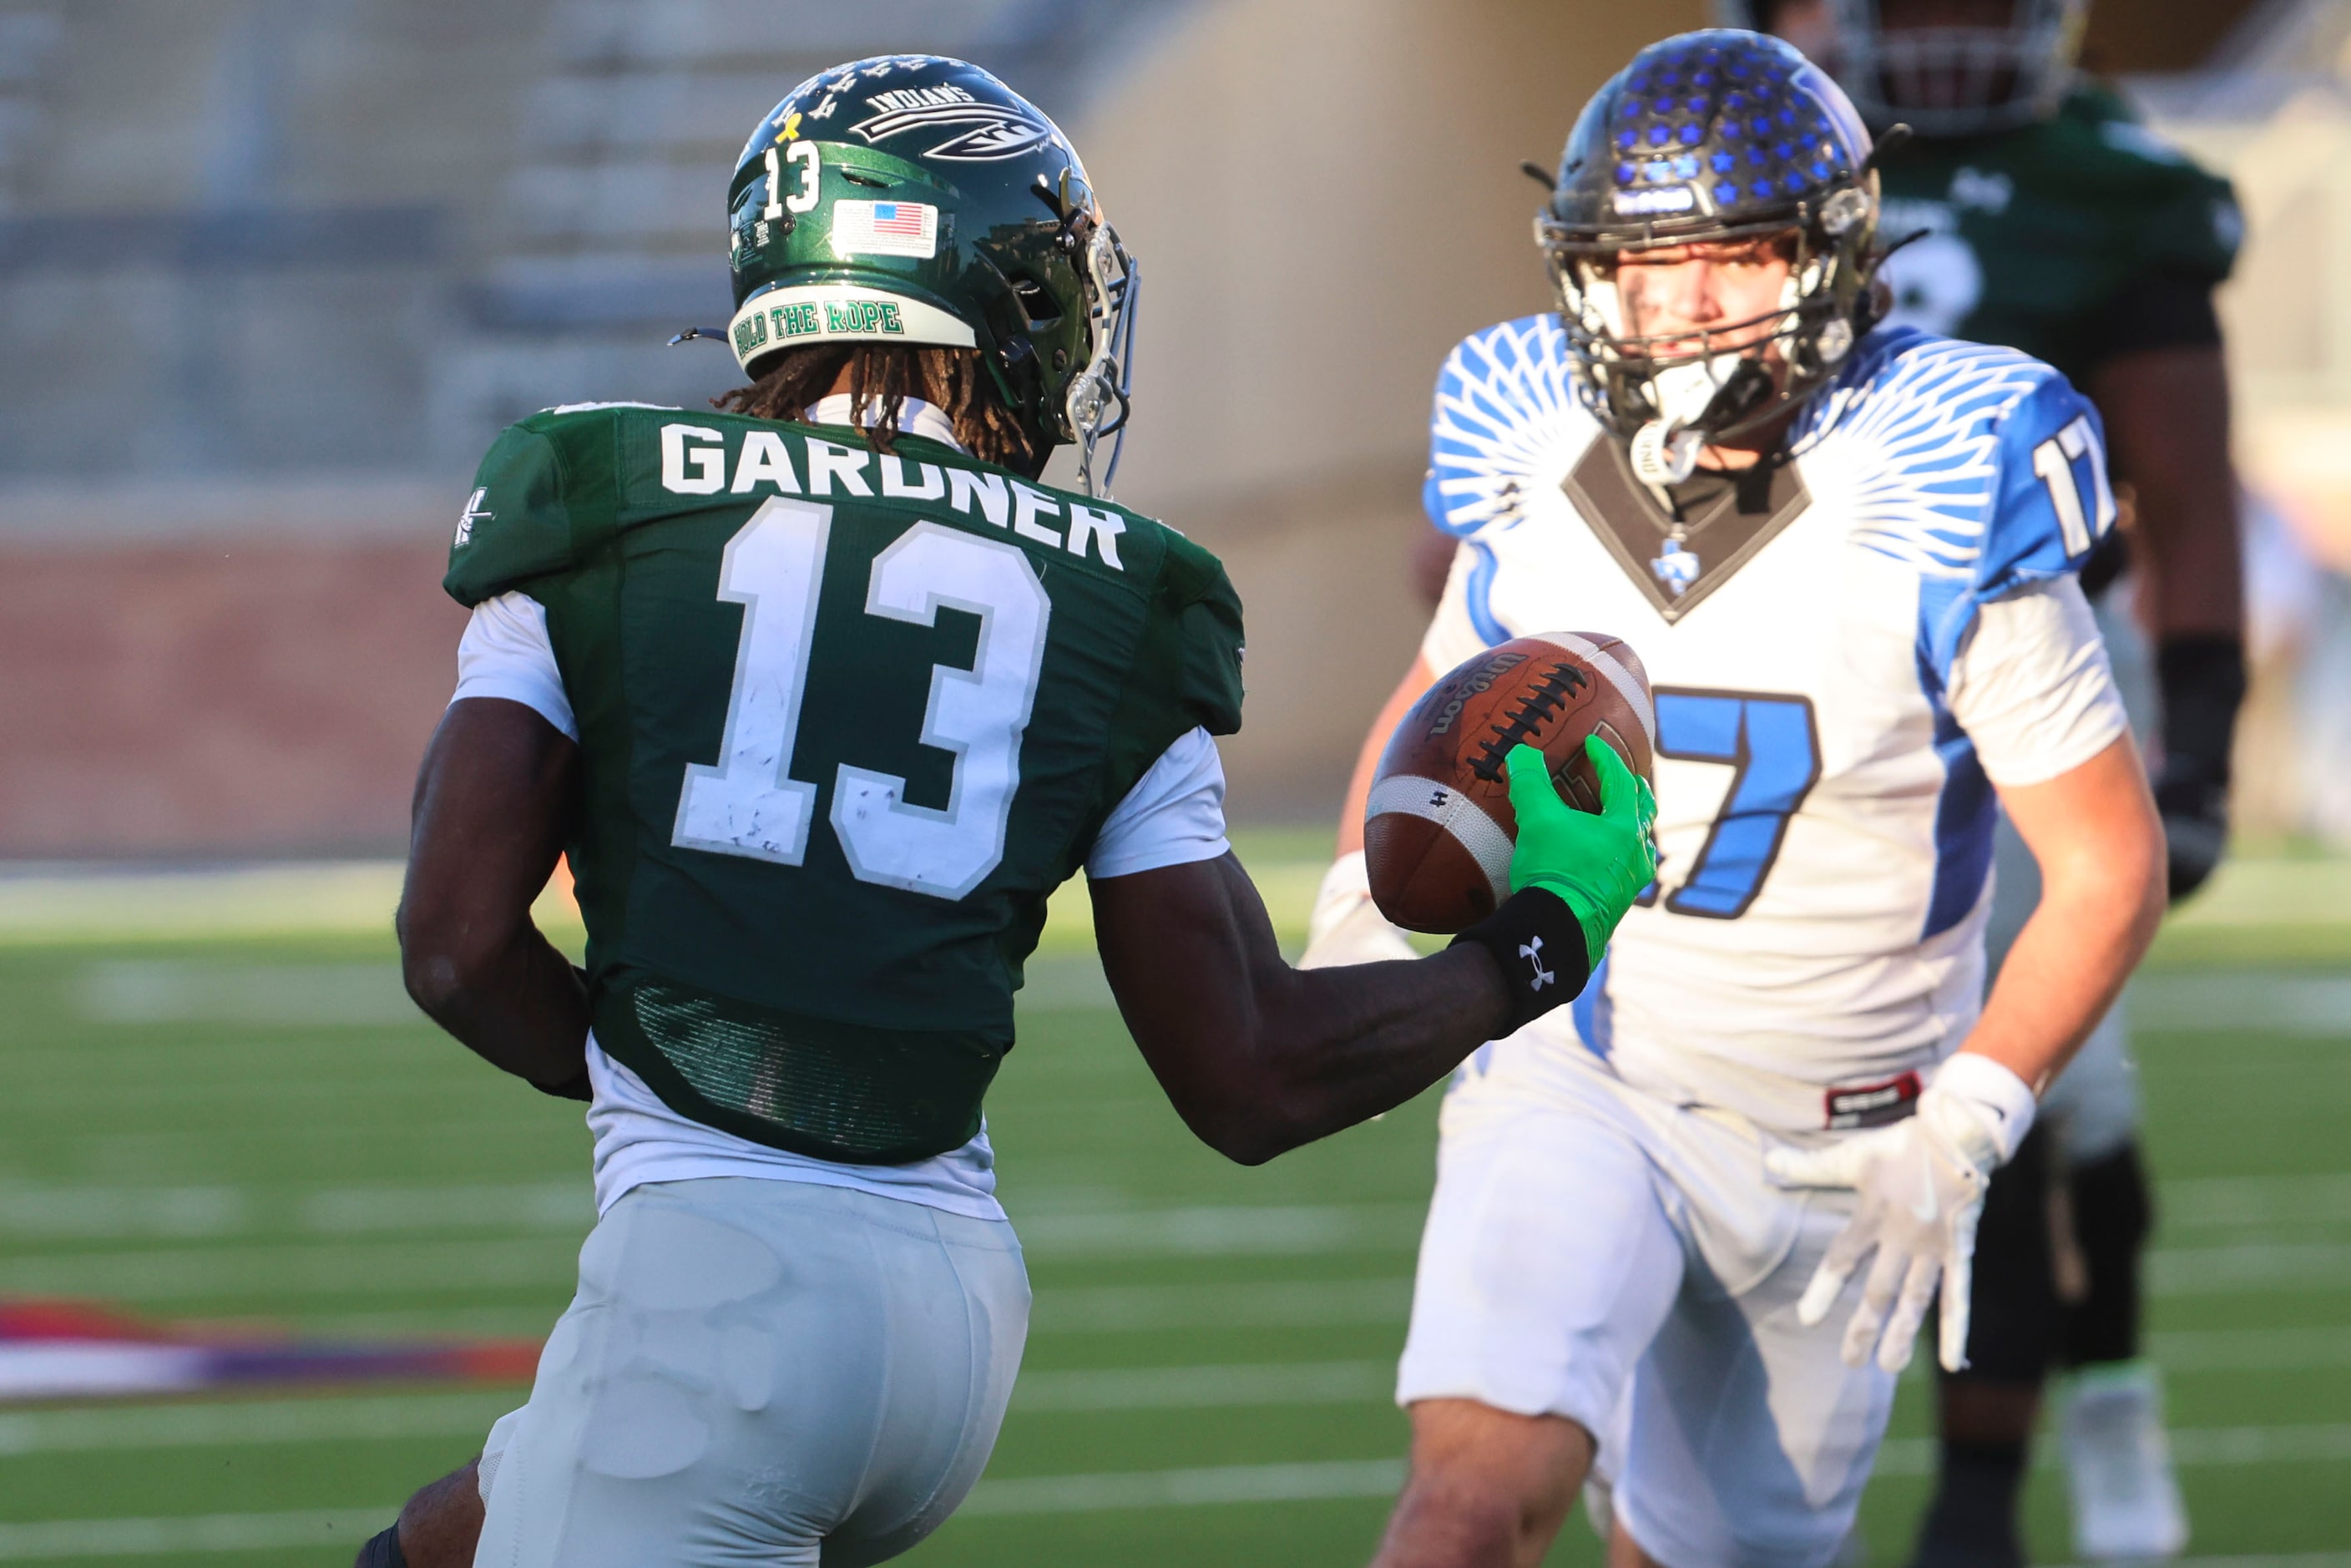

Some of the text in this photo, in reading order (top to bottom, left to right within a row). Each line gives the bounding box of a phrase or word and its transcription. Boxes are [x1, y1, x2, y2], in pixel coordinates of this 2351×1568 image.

[865, 85, 976, 114] INDIANS
[763, 139, 821, 221] 13
[733, 300, 905, 360] HOLD THE ROPE
[660, 422, 1127, 573] GARDNER
[2032, 412, 2118, 560] 17
[670, 494, 1052, 902] 13
[1426, 652, 1530, 740] Wilson
[1632, 685, 1823, 920] 7
